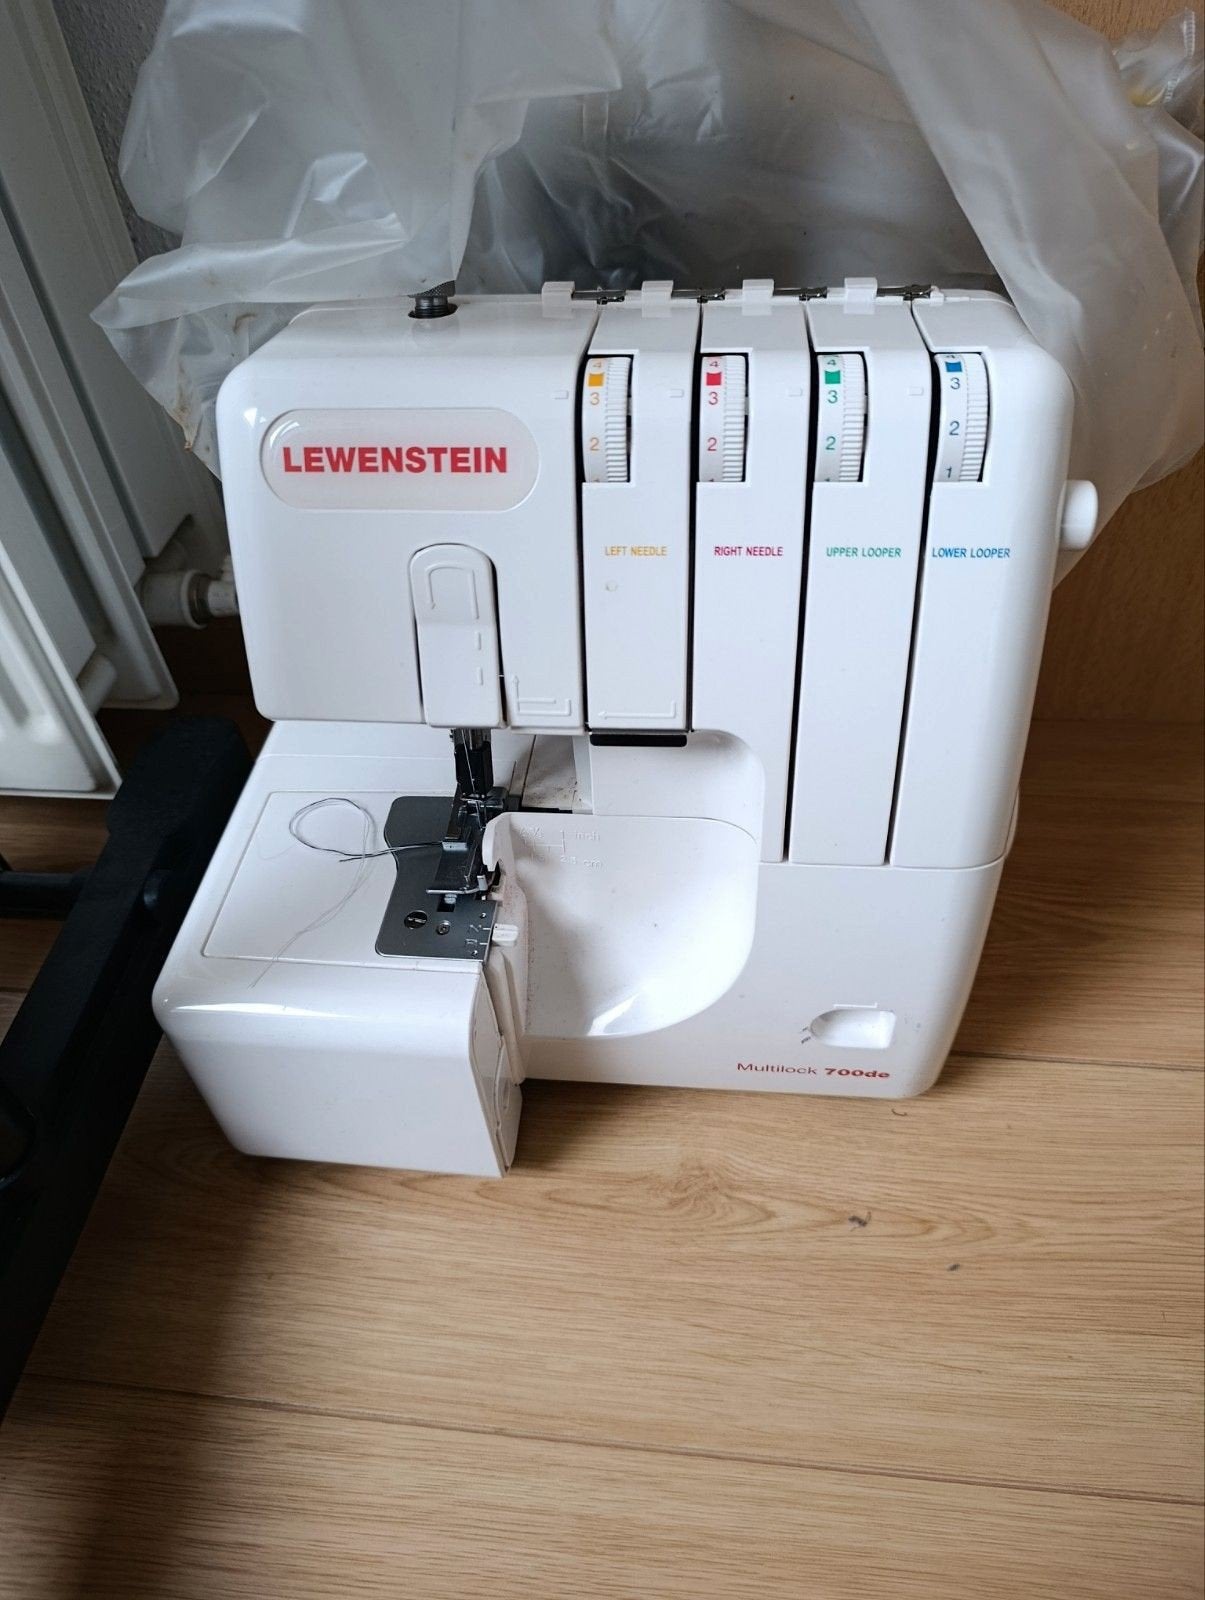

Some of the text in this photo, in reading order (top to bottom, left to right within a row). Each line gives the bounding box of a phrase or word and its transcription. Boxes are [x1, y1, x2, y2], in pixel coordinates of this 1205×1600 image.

[709, 361, 720, 369] 4
[827, 359, 837, 367] 4
[949, 377, 961, 391] 3
[589, 391, 601, 406] 3
[708, 391, 719, 406] 3
[827, 389, 839, 404] 3
[949, 420, 961, 436] 2
[589, 437, 600, 452] 2
[707, 437, 718, 452] 2
[826, 435, 837, 451] 2
[282, 446, 508, 474] LEWENSTEIN
[946, 466, 953, 479] 1
[604, 545, 668, 557] LEFT NEEDLE
[713, 546, 784, 557] RIGHT NEEDLE
[825, 546, 902, 558] UPPER LOOPER
[931, 547, 1011, 559] LOWER LOOPER
[737, 1062, 891, 1079] Multilock 700de
